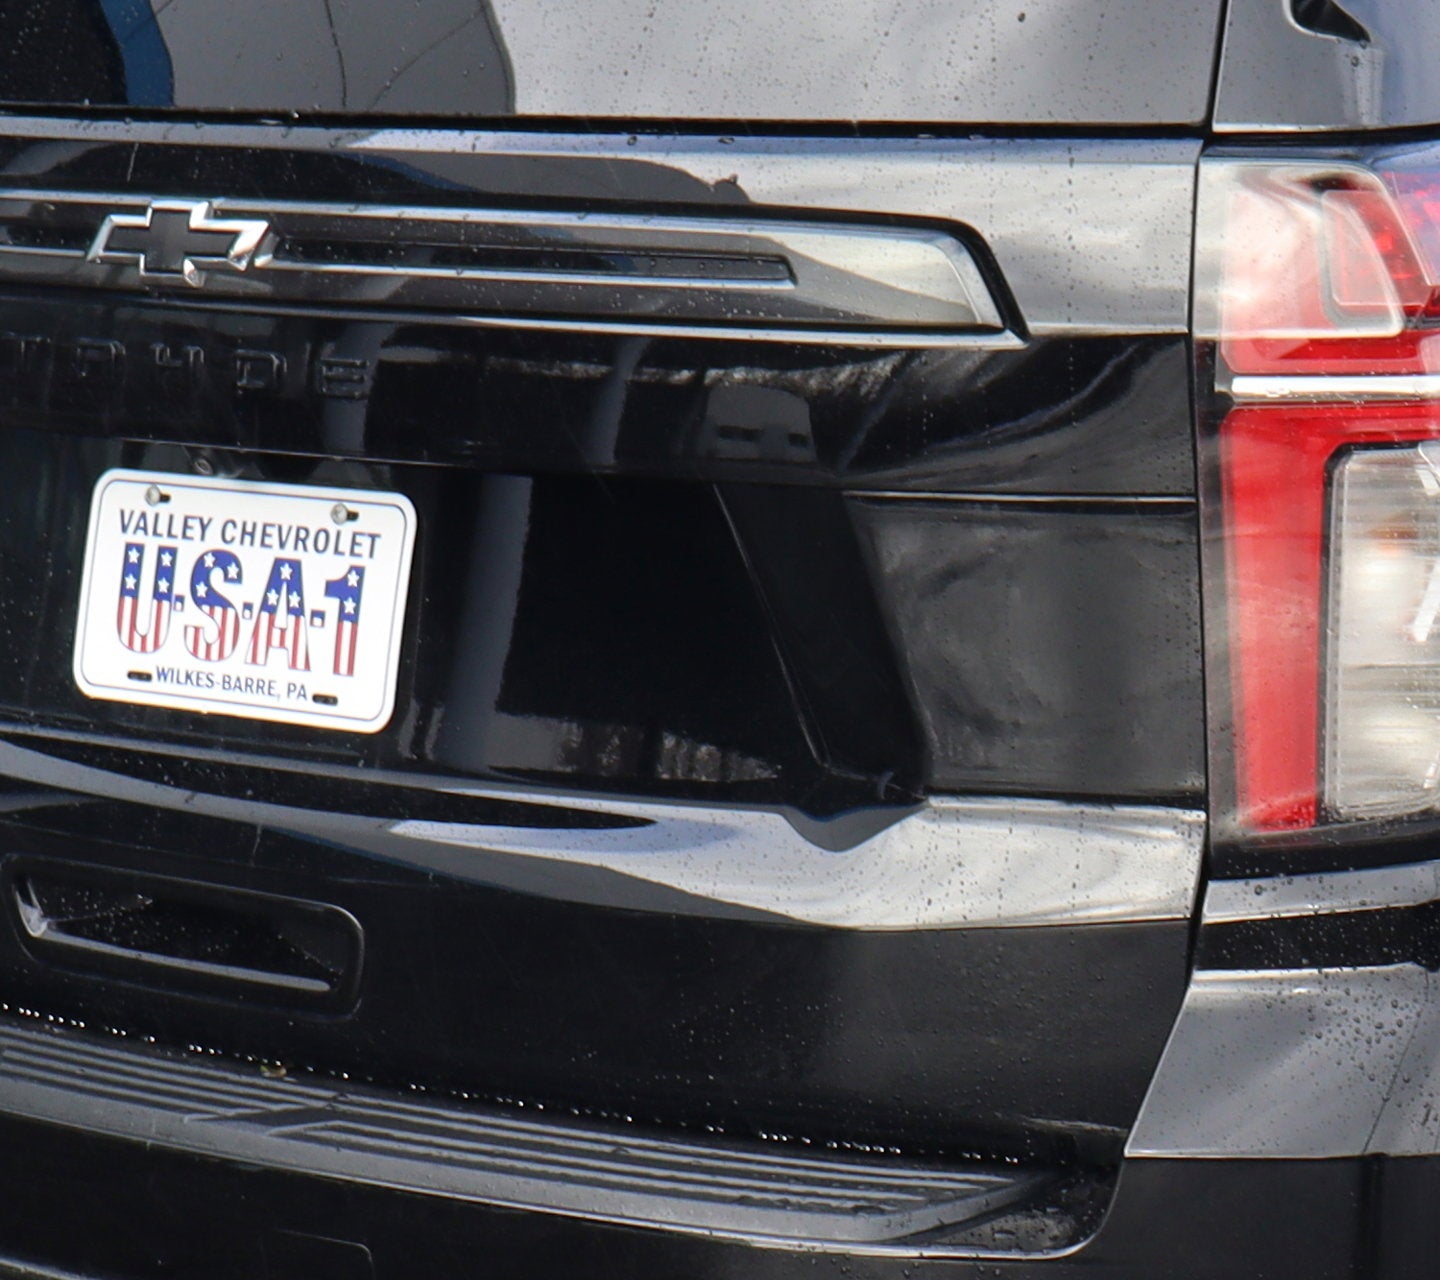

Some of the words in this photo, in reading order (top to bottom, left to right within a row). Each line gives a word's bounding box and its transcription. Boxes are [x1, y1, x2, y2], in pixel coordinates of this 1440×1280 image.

[119, 508, 213, 542] VALLEY
[221, 518, 382, 560] CHEVROLET
[155, 665, 281, 702] WILKES-BARRE,
[286, 681, 309, 702] PA
